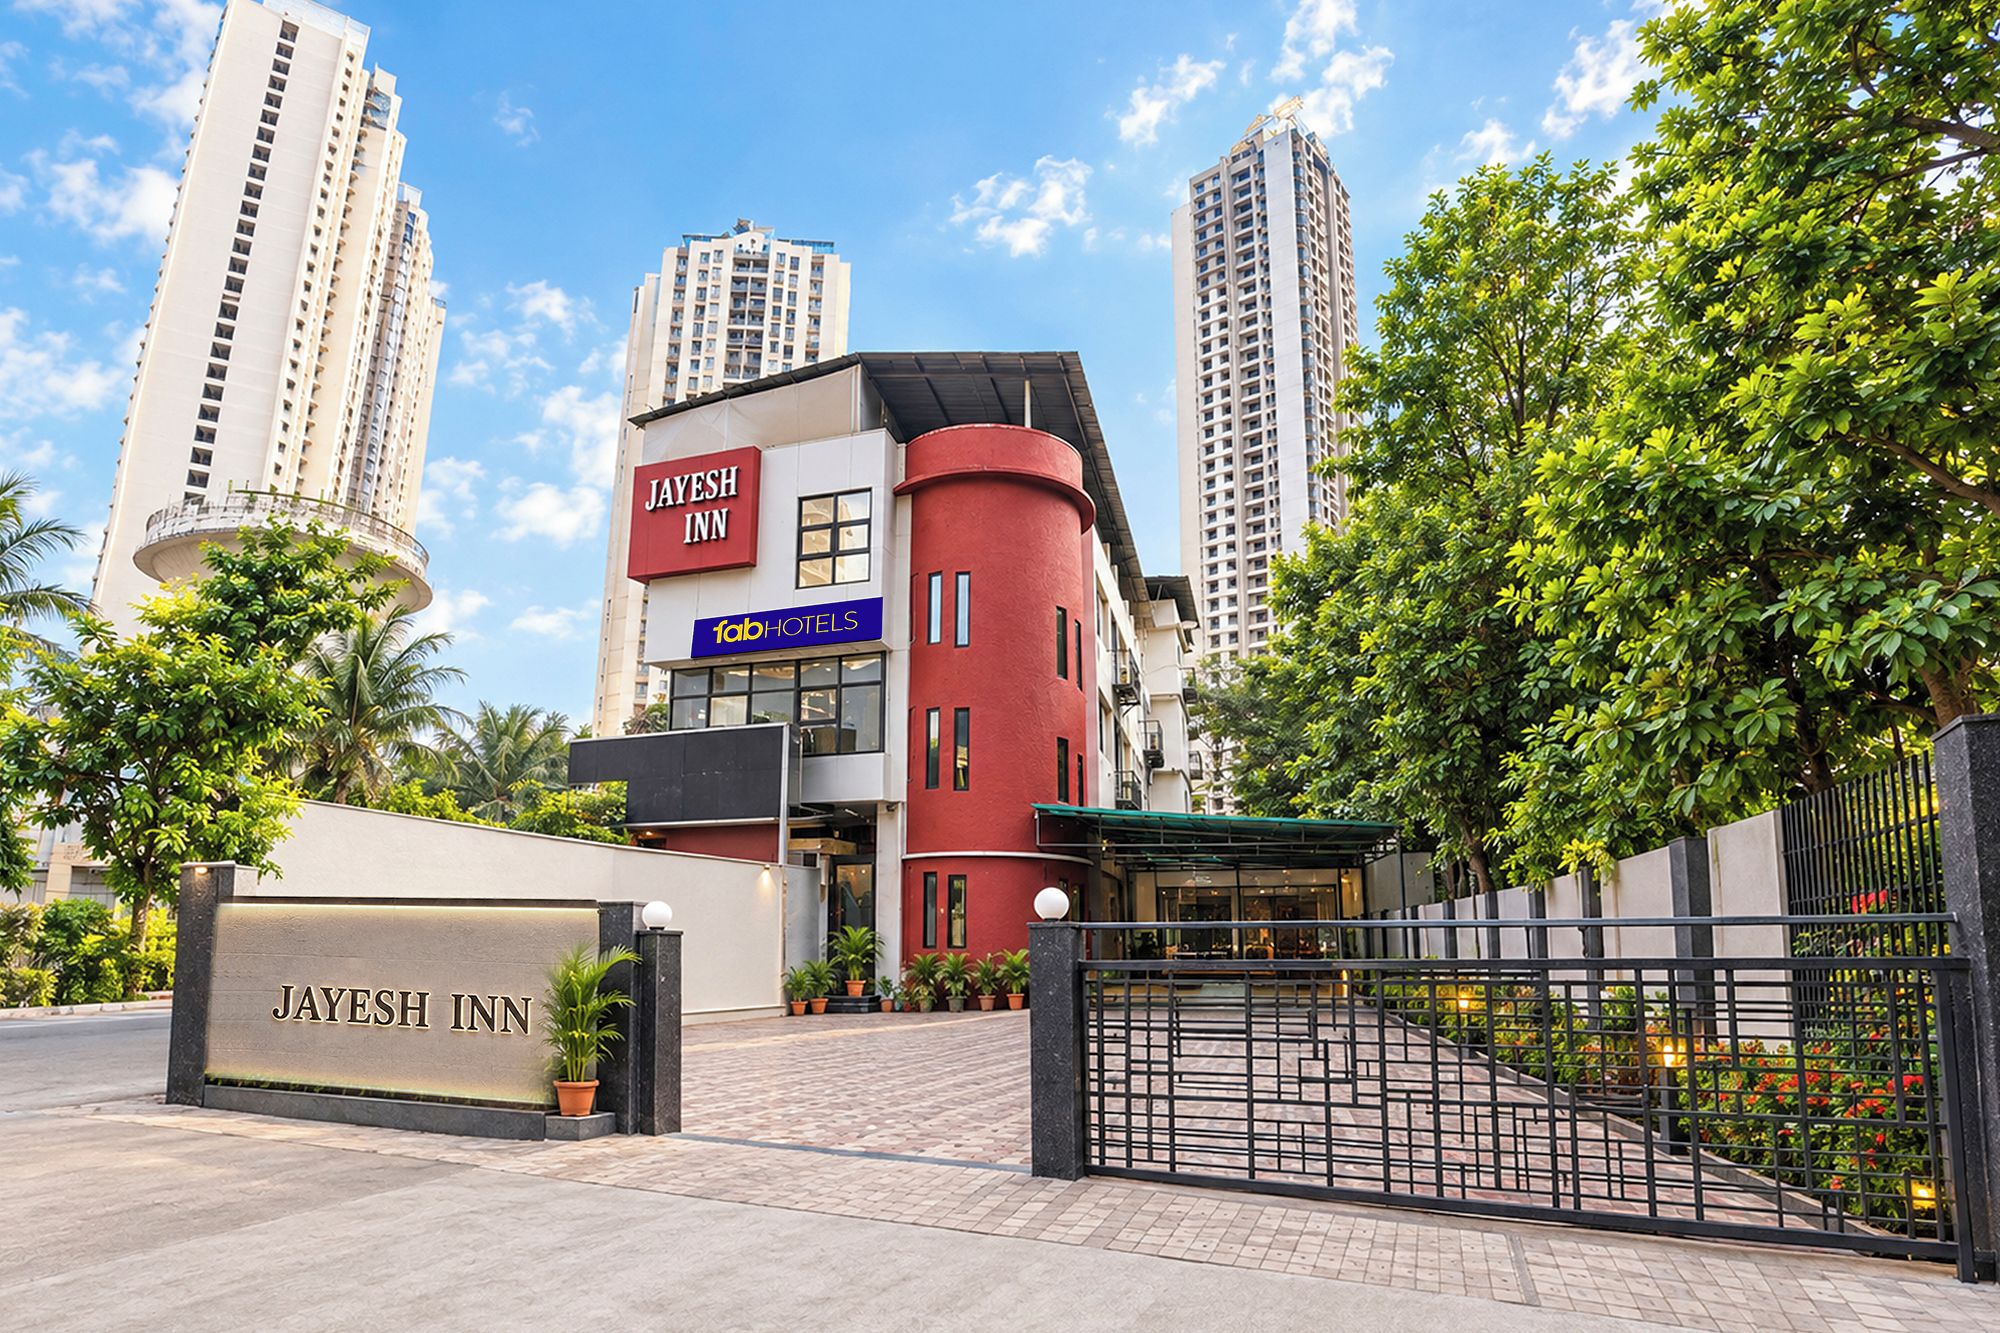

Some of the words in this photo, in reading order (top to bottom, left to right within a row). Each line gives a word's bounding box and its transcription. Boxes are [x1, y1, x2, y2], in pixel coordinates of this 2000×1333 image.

[645, 466, 738, 511] JAYESH
[683, 508, 728, 544] INN
[272, 984, 430, 1028] JAYESH
[450, 993, 532, 1035] INN
